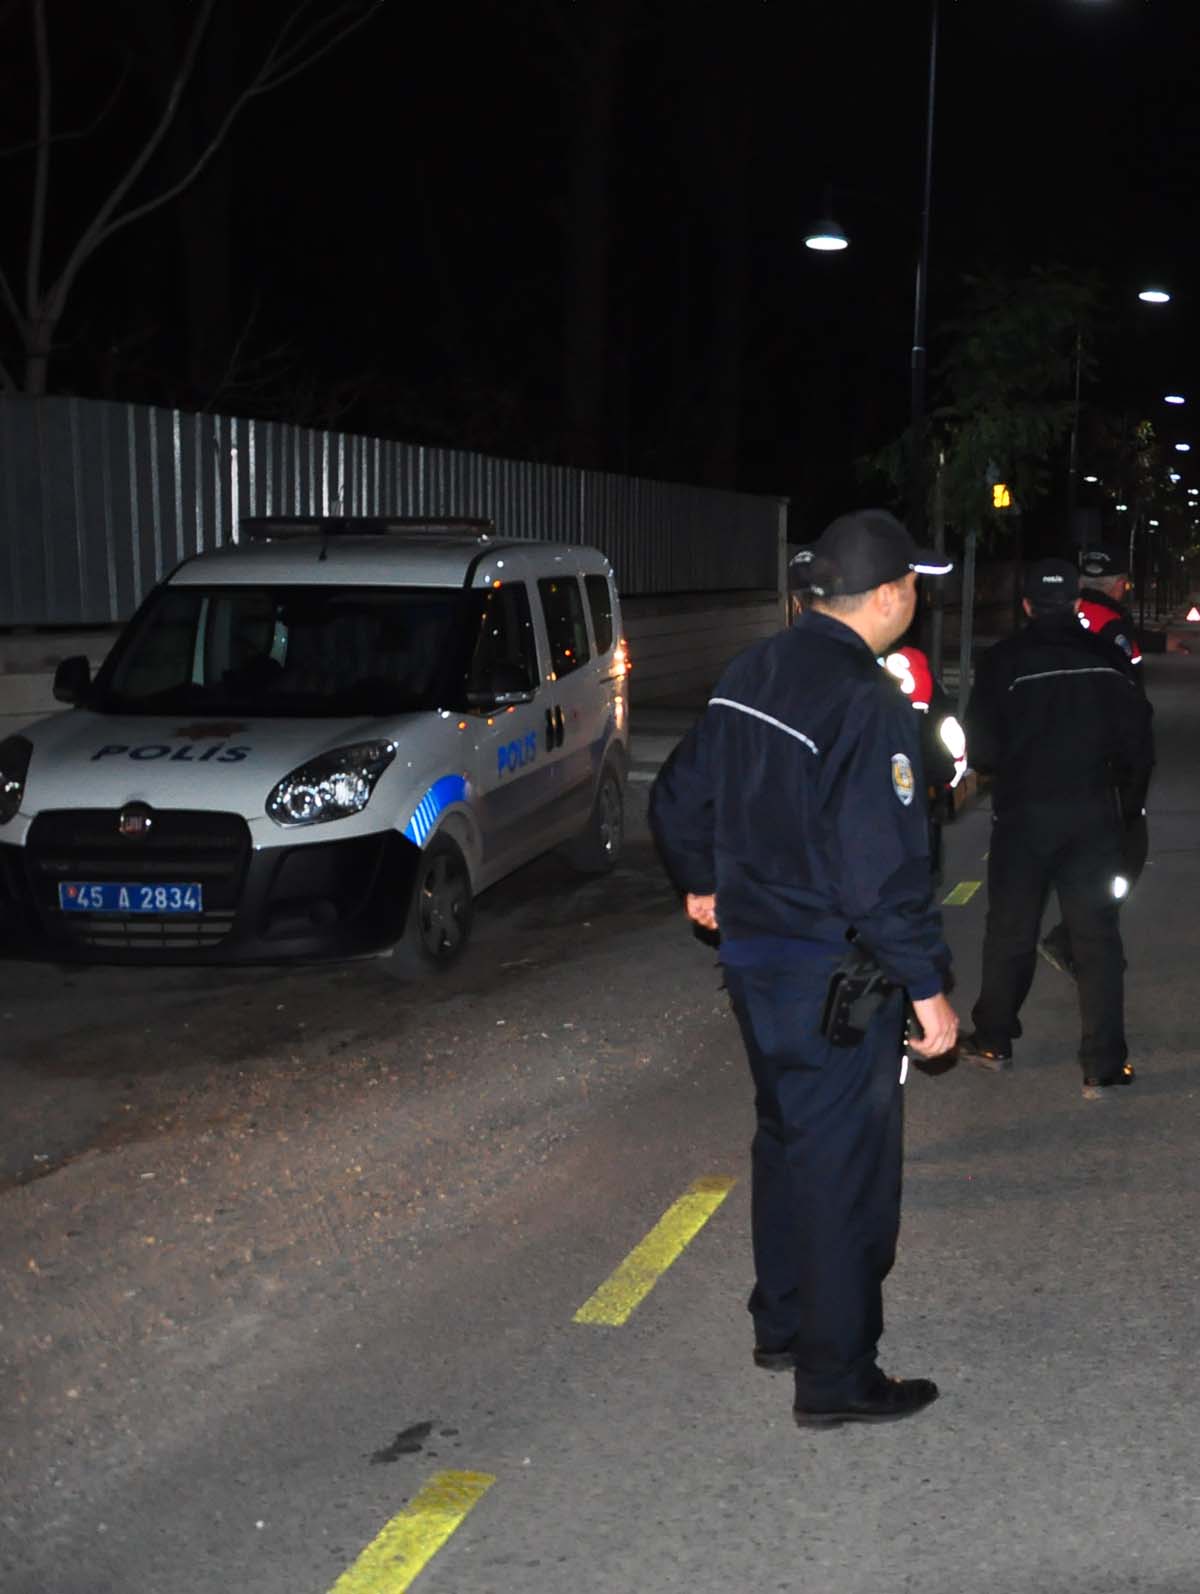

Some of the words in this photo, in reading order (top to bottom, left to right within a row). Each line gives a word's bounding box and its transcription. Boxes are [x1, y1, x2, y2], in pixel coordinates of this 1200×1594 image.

[77, 886, 103, 908] 45
[119, 886, 130, 908] A
[140, 887, 197, 909] 2834
